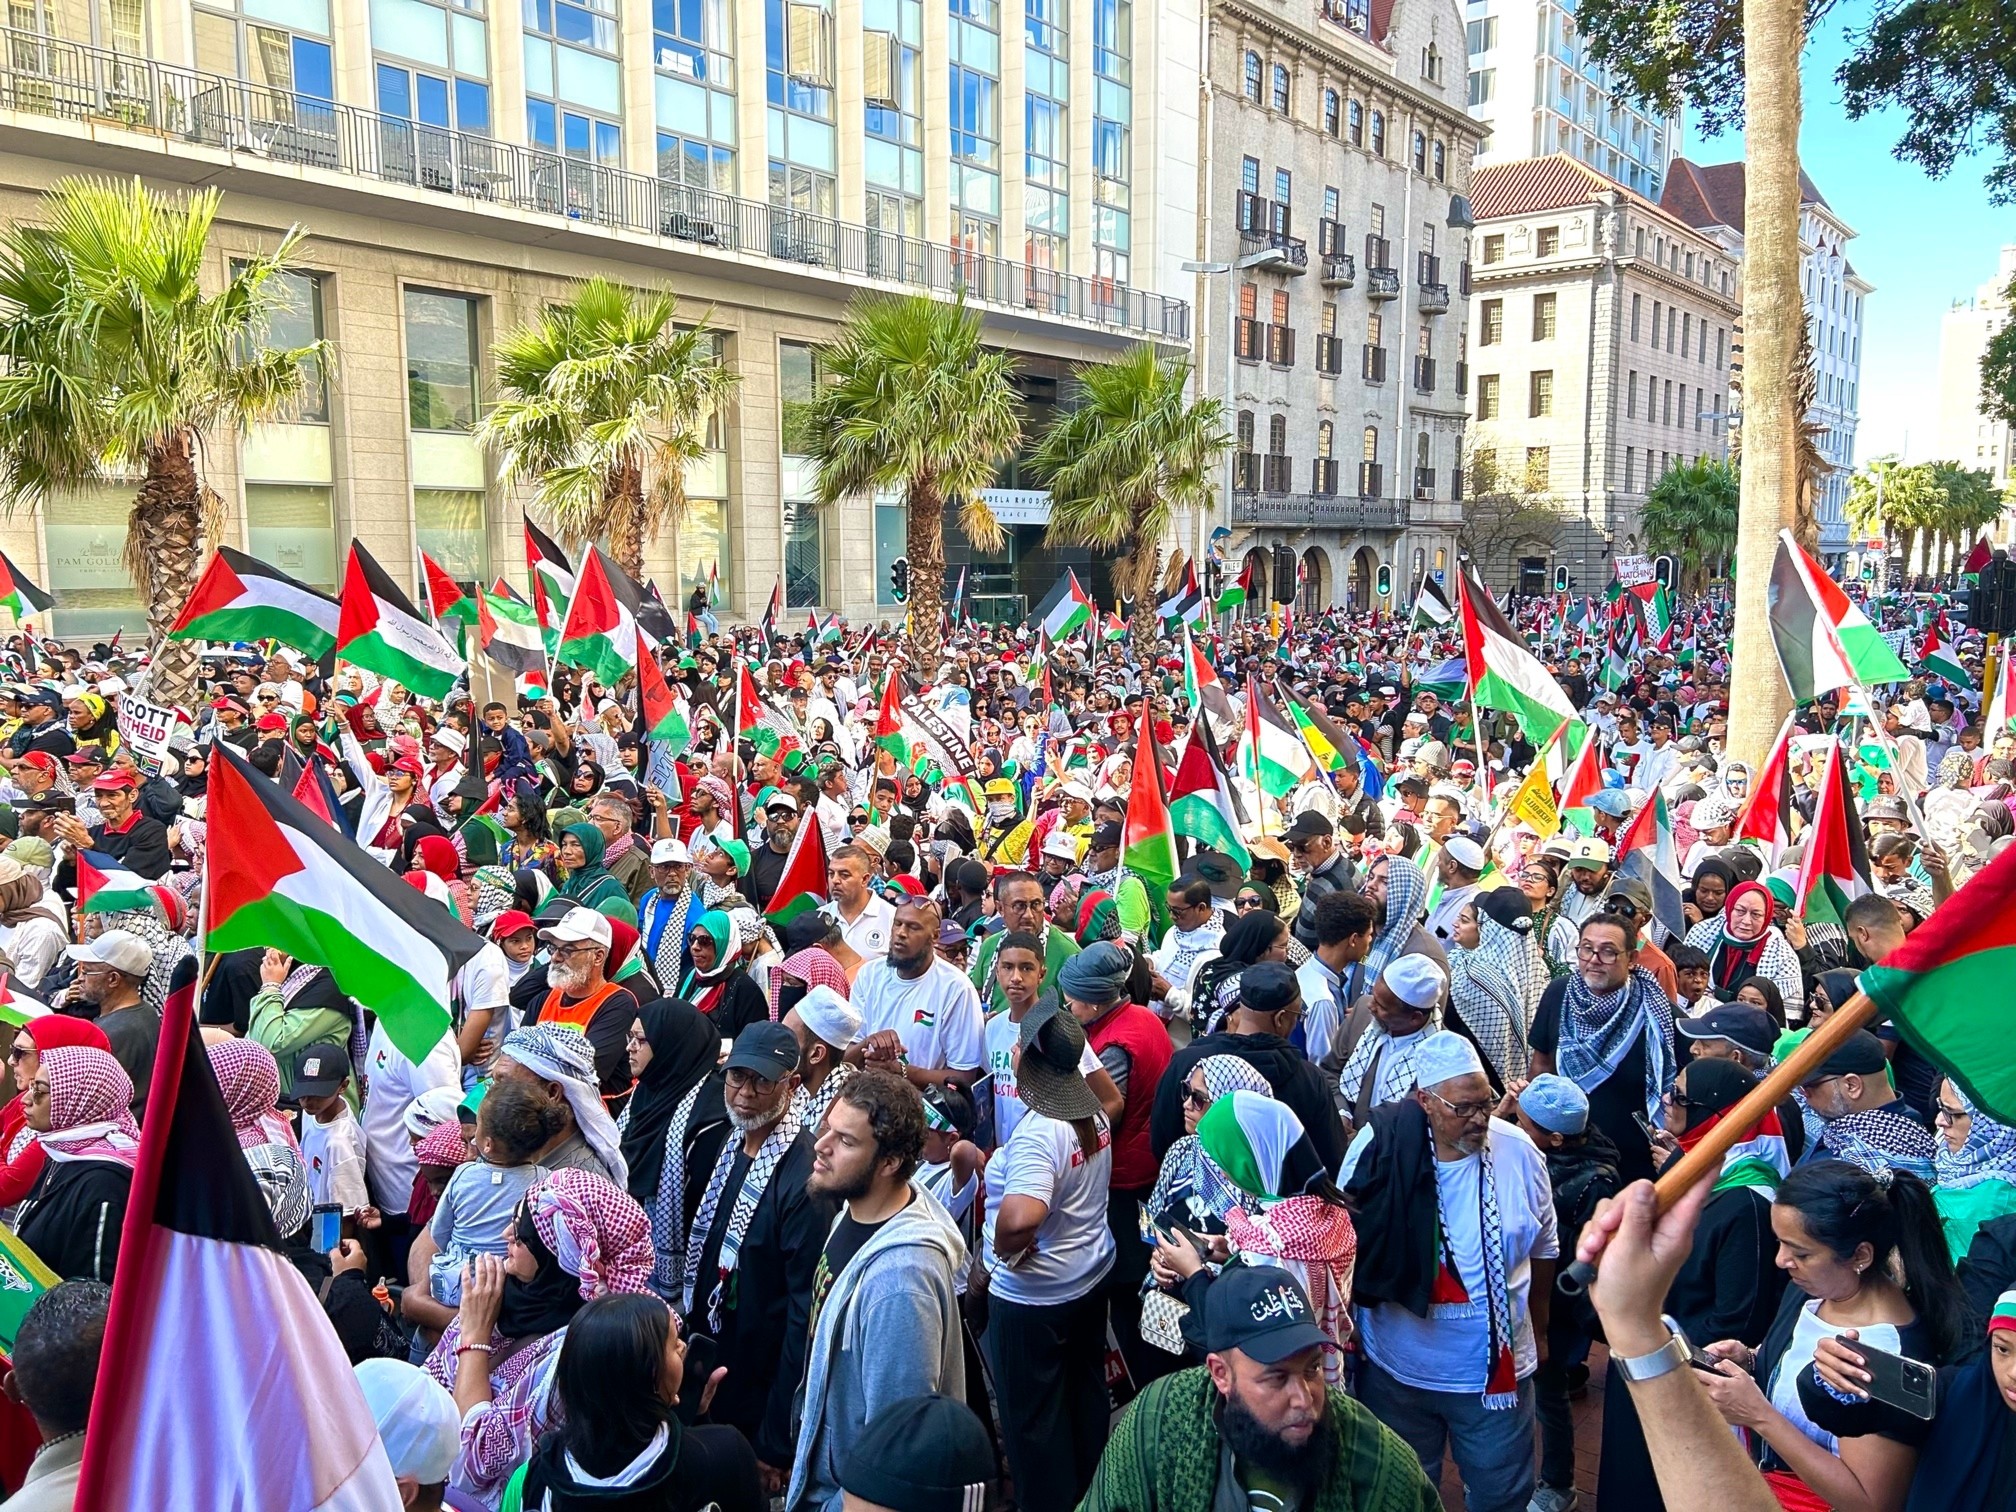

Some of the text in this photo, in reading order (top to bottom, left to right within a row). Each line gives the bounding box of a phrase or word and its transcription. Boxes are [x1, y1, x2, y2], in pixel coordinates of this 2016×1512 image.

[57, 557, 81, 566] PAM
[1617, 558, 1631, 567] THE
[1619, 568, 1654, 579] WATCHING
[900, 693, 974, 770] PALESTINE
[1581, 845, 1591, 857] C
